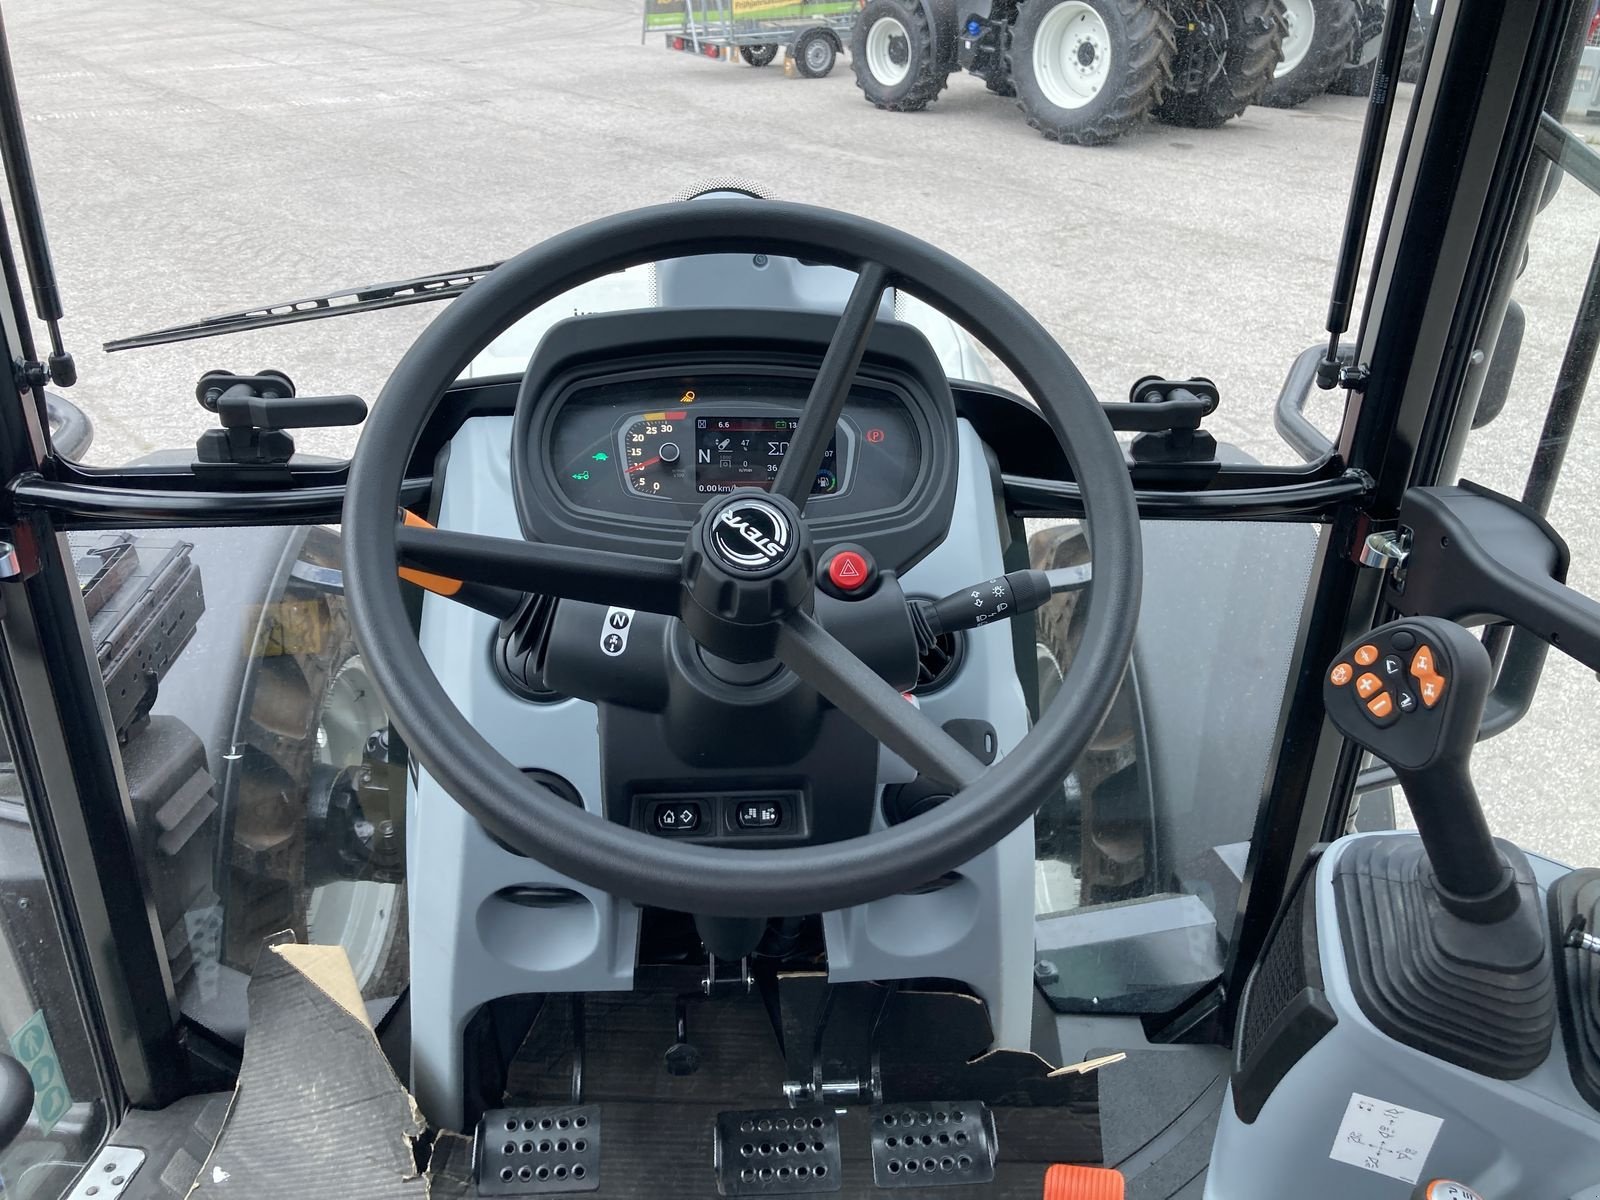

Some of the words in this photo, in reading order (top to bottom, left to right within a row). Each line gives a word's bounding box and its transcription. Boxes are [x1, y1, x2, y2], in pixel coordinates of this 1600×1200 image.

[646, 426, 658, 435] 25
[661, 425, 673, 433] 30
[632, 434, 645, 442] 20
[631, 448, 642, 456] 15
[698, 448, 711, 463] N
[743, 460, 748, 468] 0
[639, 478, 646, 486] 5
[653, 482, 660, 490] 0
[698, 484, 717, 492] 0.00
[721, 509, 785, 557] STEYR
[612, 613, 626, 627] N
